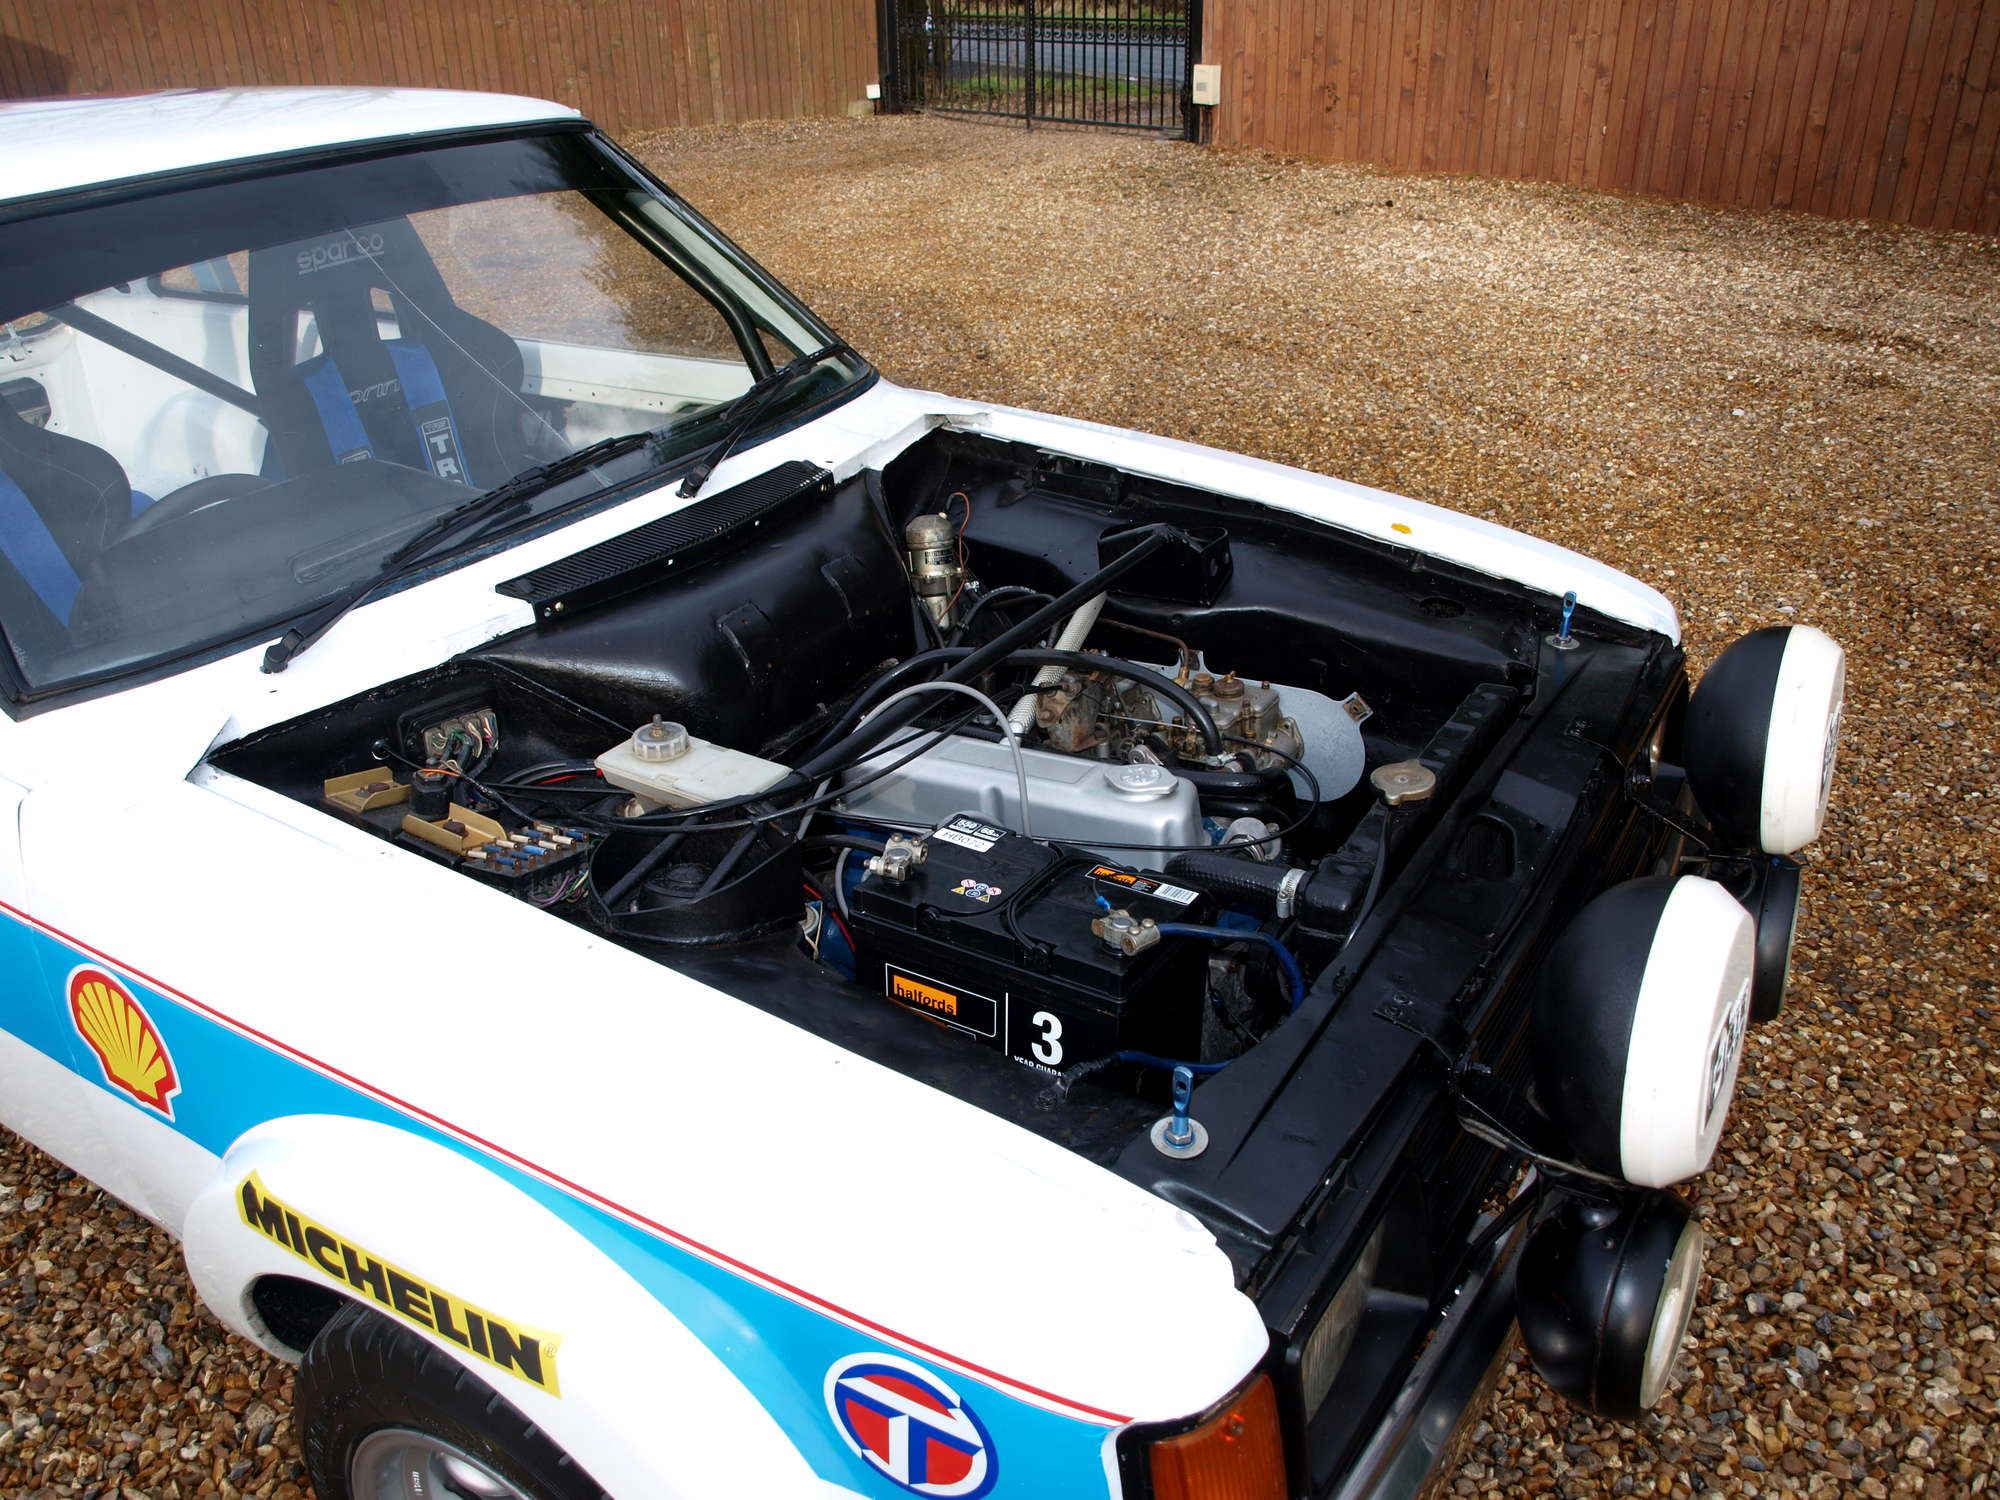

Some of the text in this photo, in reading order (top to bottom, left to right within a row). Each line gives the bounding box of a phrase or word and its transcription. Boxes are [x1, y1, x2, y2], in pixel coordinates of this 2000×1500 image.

[297, 233, 384, 274] sparco
[429, 433, 461, 484] TR
[896, 983, 955, 1014] halfords
[1032, 1011, 1063, 1065] 3
[241, 1180, 545, 1386] MICHELIN
